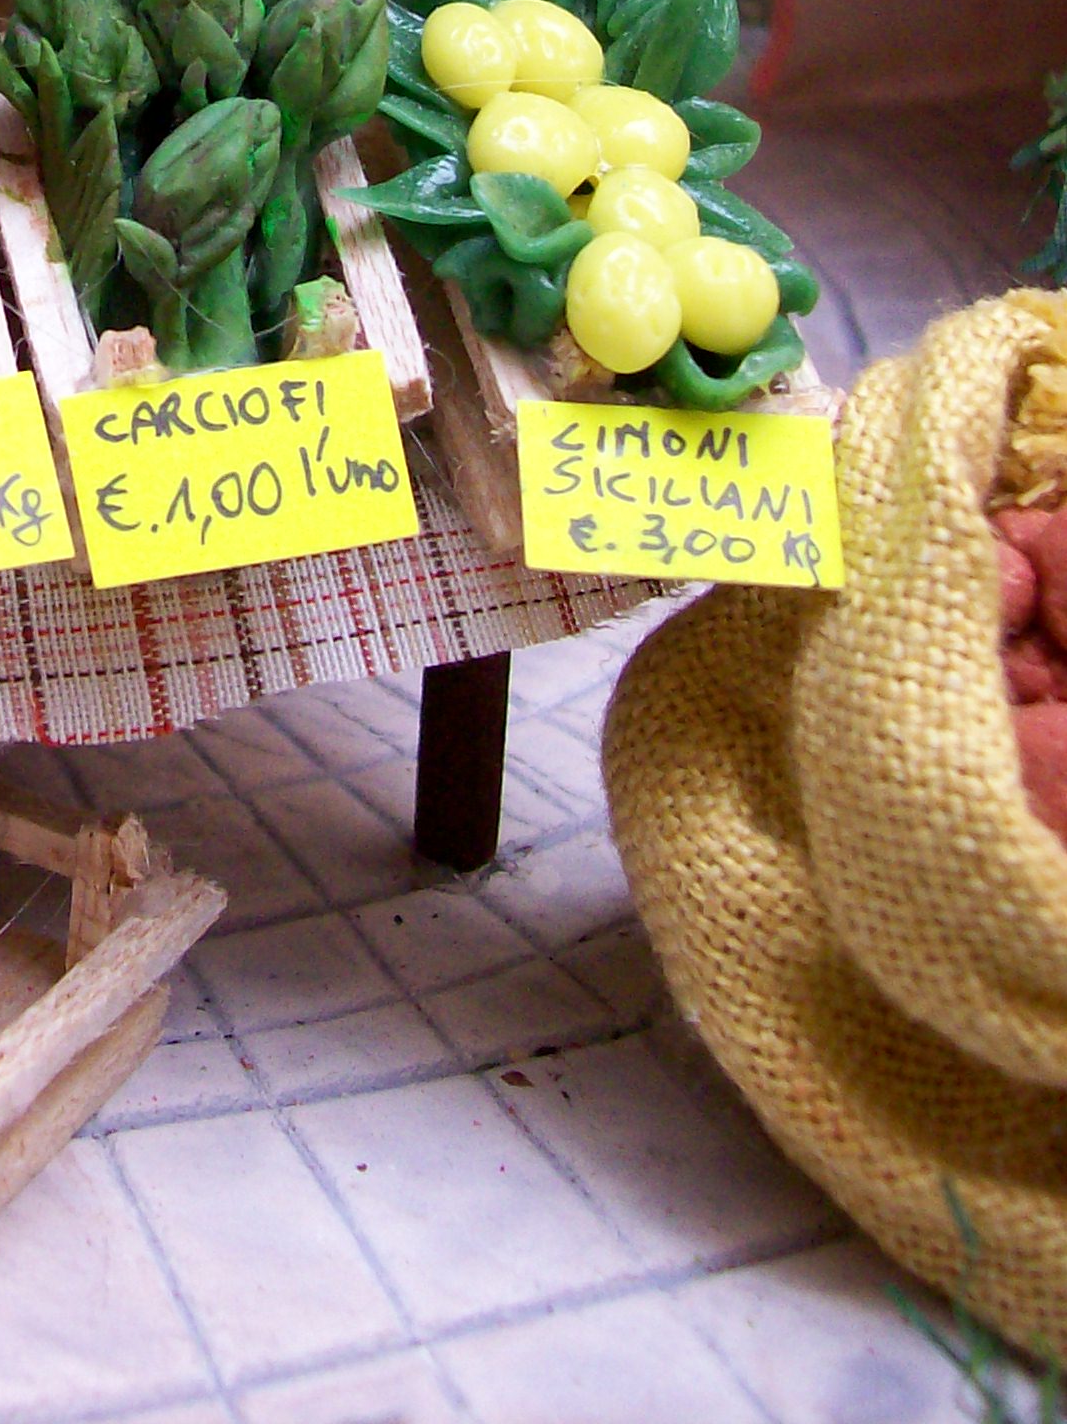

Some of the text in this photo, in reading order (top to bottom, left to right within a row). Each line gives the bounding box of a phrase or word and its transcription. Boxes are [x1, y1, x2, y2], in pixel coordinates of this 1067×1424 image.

[94, 380, 326, 446] CARCIOFI
[550, 420, 750, 469] LIMONI
[543, 455, 814, 526] SICILIANI
